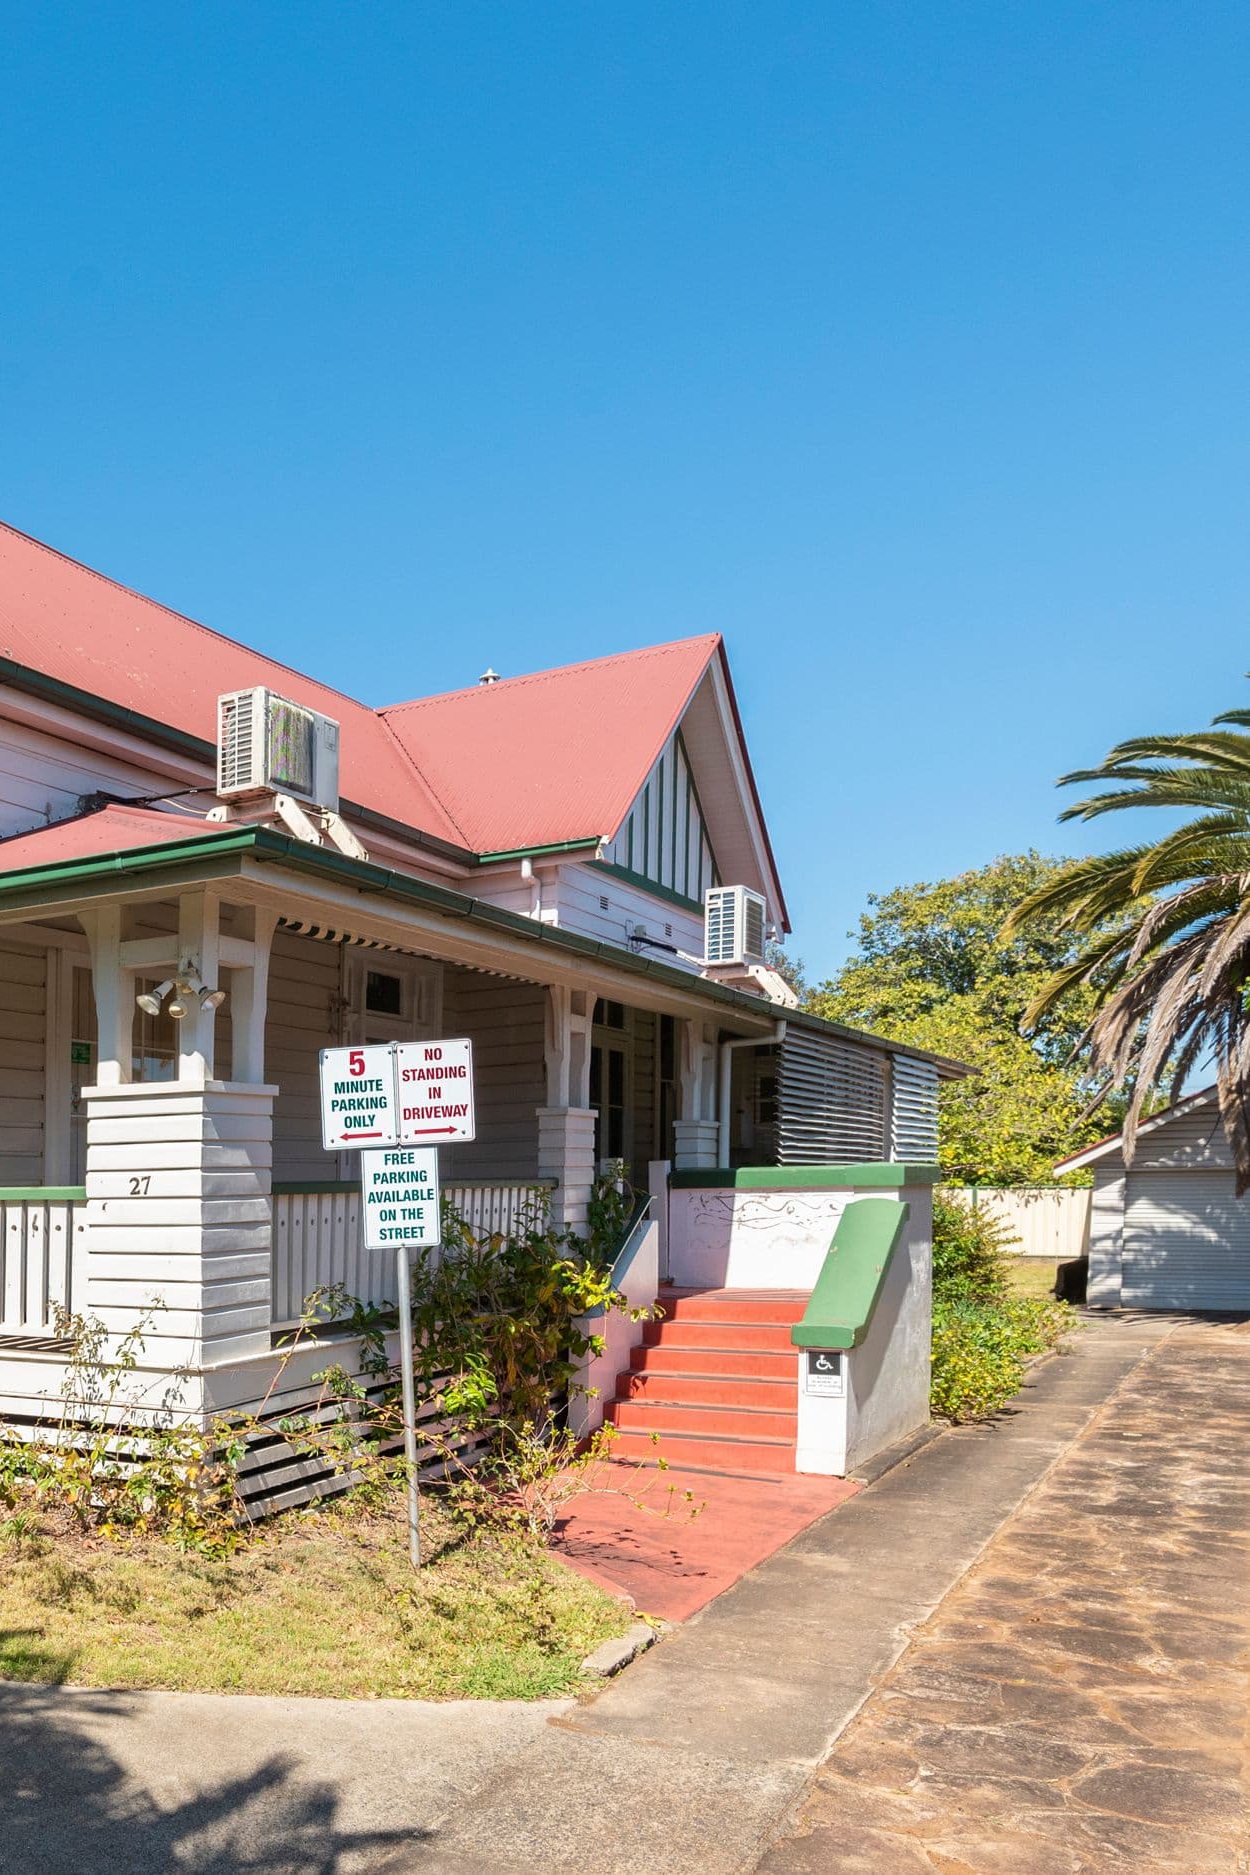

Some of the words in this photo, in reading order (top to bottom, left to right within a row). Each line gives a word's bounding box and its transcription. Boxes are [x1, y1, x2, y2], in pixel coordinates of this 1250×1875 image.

[424, 1047, 443, 1061] NO
[348, 1050, 366, 1077] 5
[402, 1065, 467, 1082] STANDING
[334, 1079, 383, 1095] MINUTE
[428, 1086, 442, 1100] IN
[331, 1096, 388, 1112] PARKING
[403, 1103, 469, 1121] DRIVEWAY
[344, 1114, 376, 1129] ONLY
[384, 1152, 415, 1165] FREE
[128, 1175, 152, 1195] 27
[373, 1169, 428, 1185] PARKING
[367, 1188, 435, 1204] AVAILABLE
[379, 1208, 397, 1222] ON
[400, 1207, 424, 1220] THE
[379, 1226, 425, 1240] STREET
